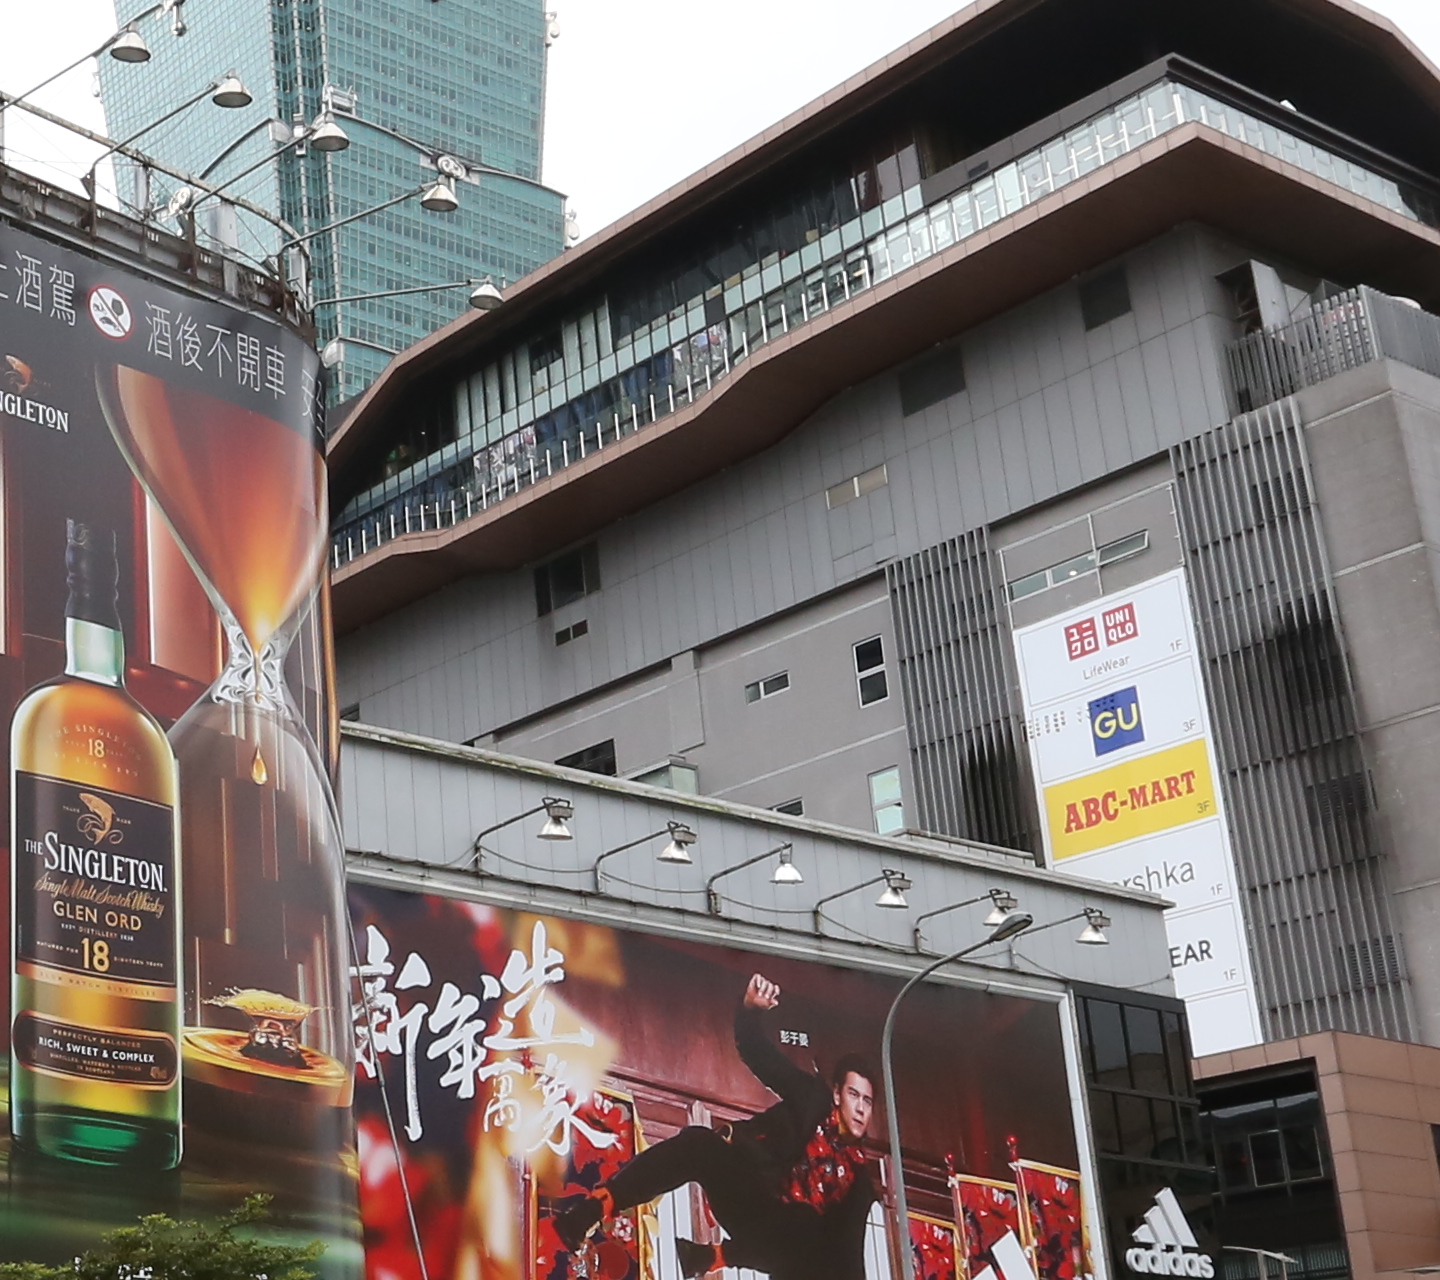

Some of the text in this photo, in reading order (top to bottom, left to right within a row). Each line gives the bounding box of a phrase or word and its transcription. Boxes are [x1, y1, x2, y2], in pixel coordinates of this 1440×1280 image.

[145, 300, 286, 400] 酒後不開車
[1170, 639, 1183, 653] 1F
[1083, 655, 1130, 680] LifeWear
[1094, 702, 1140, 740] GU
[1182, 719, 1196, 733] 3F
[87, 738, 106, 759] 18
[1064, 771, 1197, 835] ABC-MART
[1196, 799, 1211, 815] 3F
[24, 838, 44, 856] THE
[1120, 860, 1196, 890] rshka
[33, 871, 165, 918] Single Malt Scotch Whisky
[1209, 882, 1224, 897] 1F
[53, 900, 142, 932] GLEN ORD
[81, 937, 110, 972] 18
[1223, 967, 1238, 982] 1F
[66, 1042, 98, 1058] SWEET
[102, 1048, 109, 1059] &
[112, 1049, 155, 1064] COMPLEX
[1125, 1236, 1214, 1280] adidas
